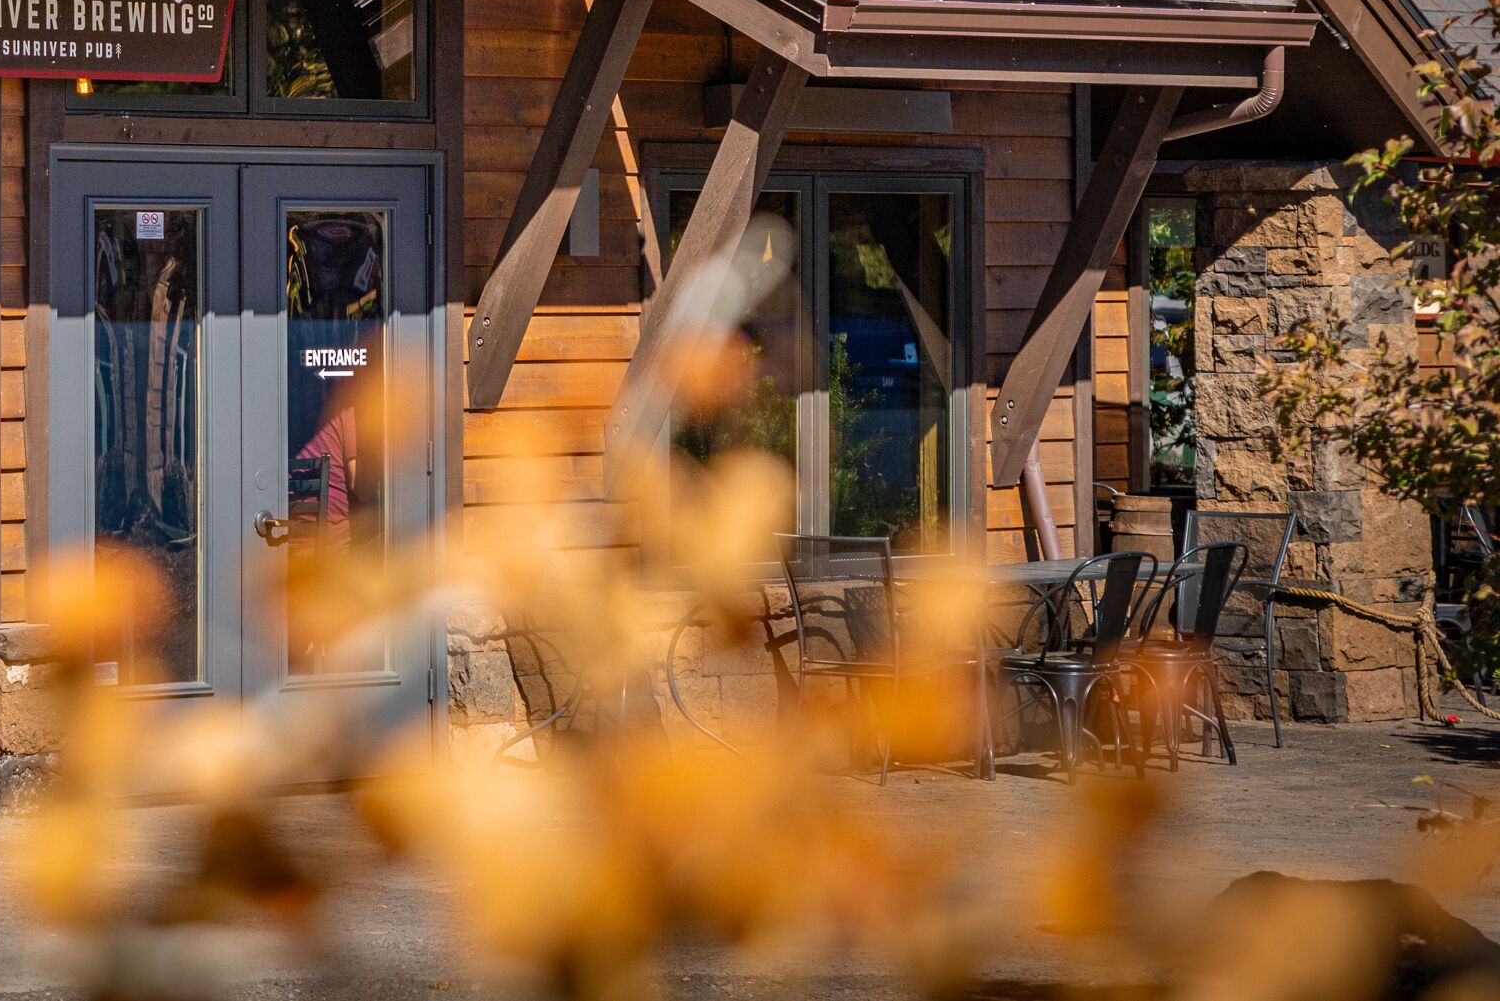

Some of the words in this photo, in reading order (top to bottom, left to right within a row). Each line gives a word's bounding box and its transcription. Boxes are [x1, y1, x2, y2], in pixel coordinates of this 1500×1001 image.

[73, 0, 194, 34] BREWING
[198, 4, 215, 21] CO
[2, 39, 78, 56] SUNRIVER
[85, 41, 114, 58] PUB
[305, 349, 367, 366] ENTRANCE
